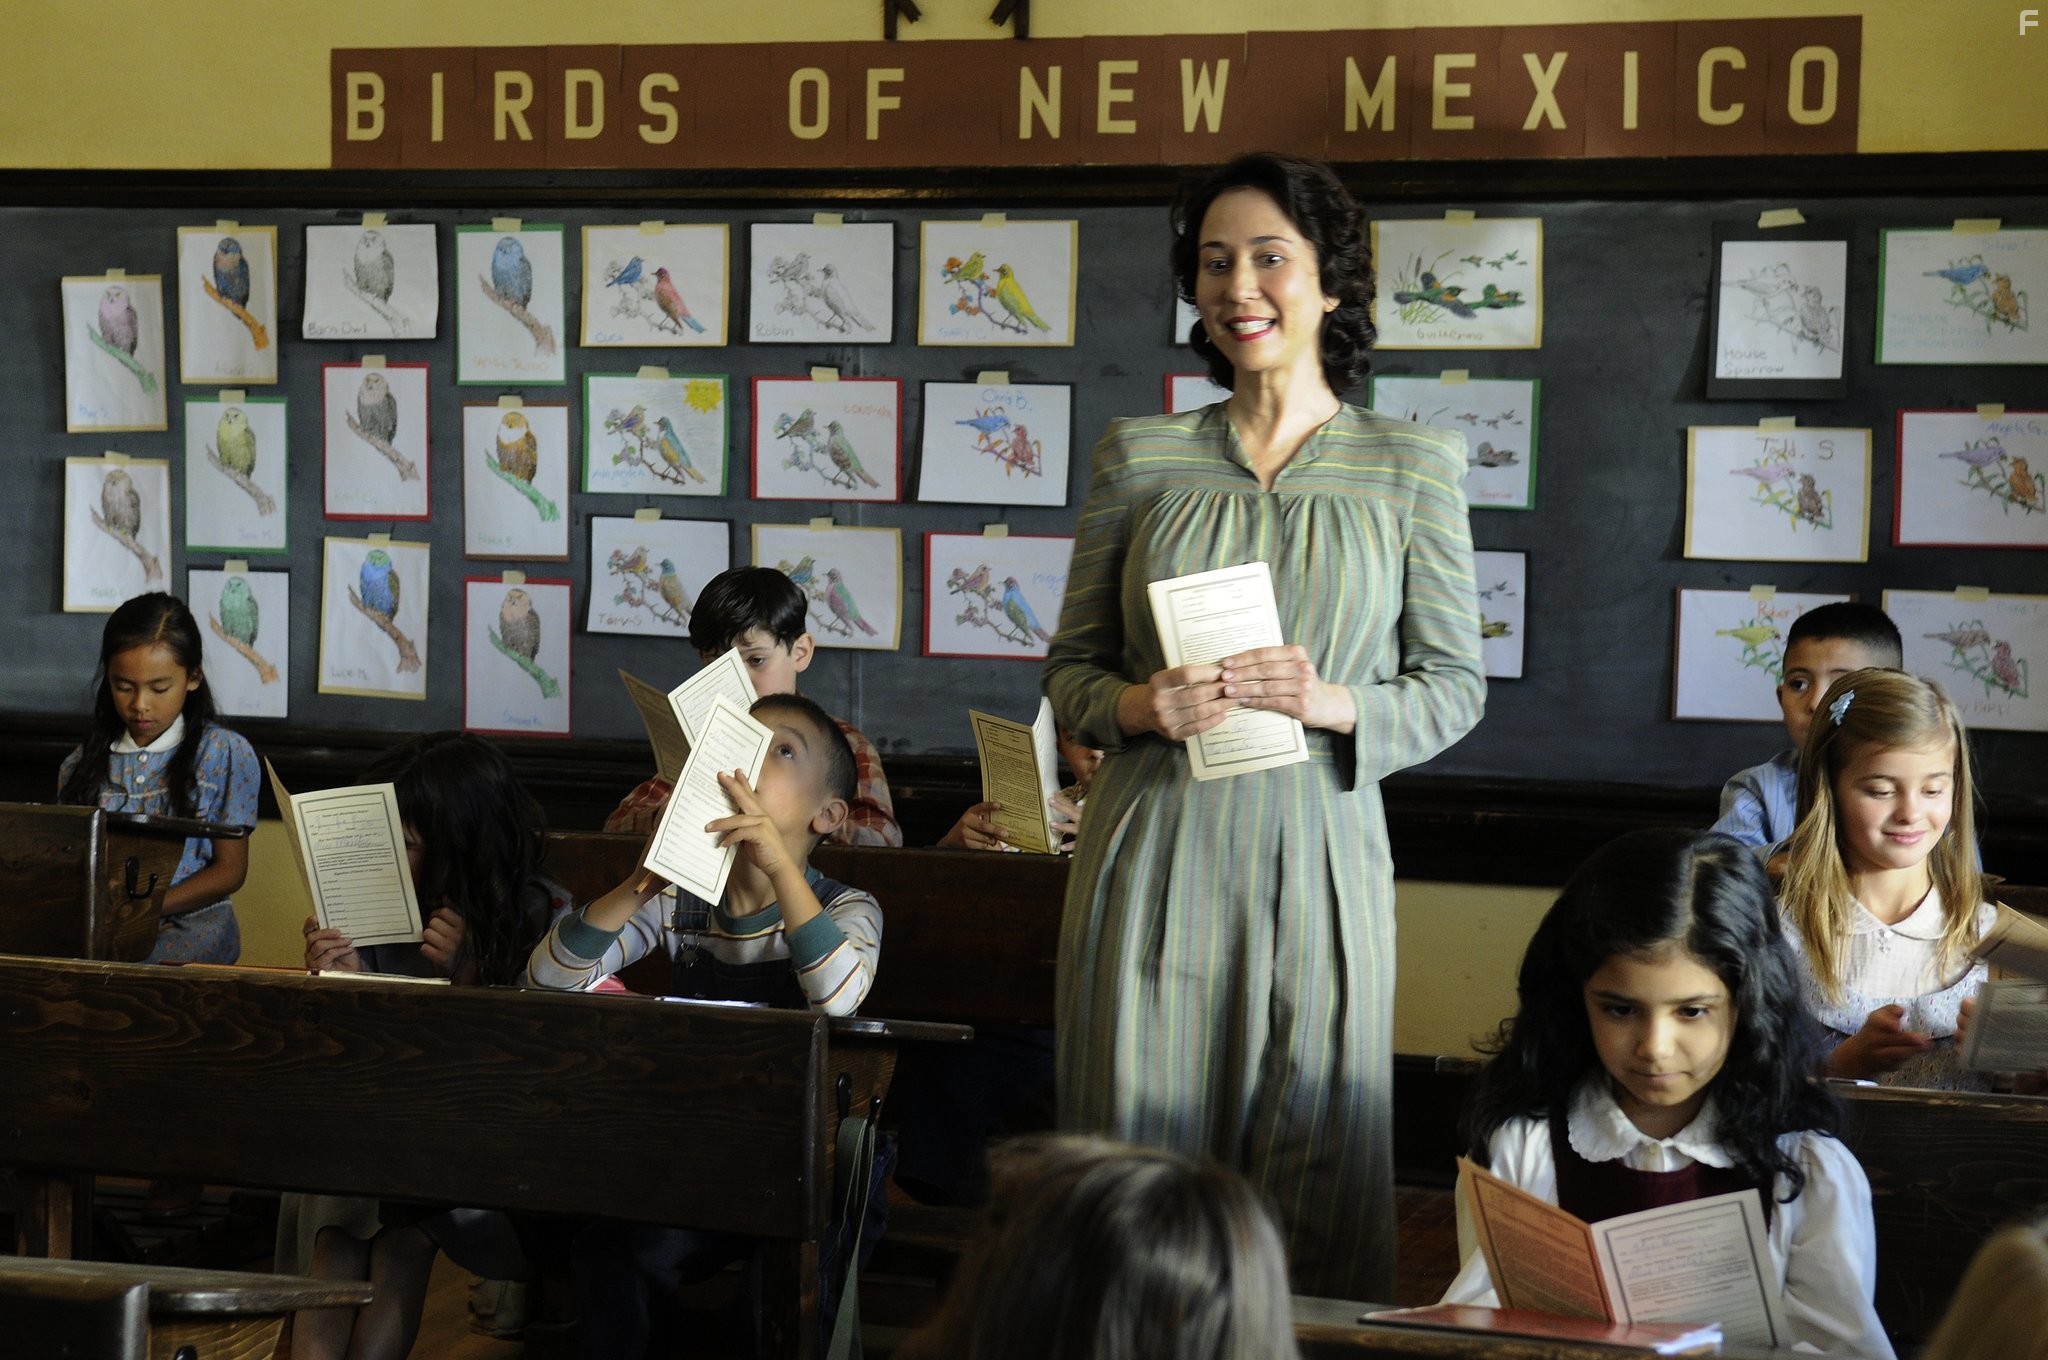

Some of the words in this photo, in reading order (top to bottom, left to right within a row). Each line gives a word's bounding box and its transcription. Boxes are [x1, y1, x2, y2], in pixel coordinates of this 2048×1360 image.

[346, 69, 679, 143] BIRDS
[790, 68, 904, 139] OF
[1020, 59, 1229, 138] NEW
[1346, 47, 1838, 131] MEXICO
[756, 322, 795, 338] Robin
[1724, 348, 1768, 360] House
[1724, 362, 1784, 378] Sparrow
